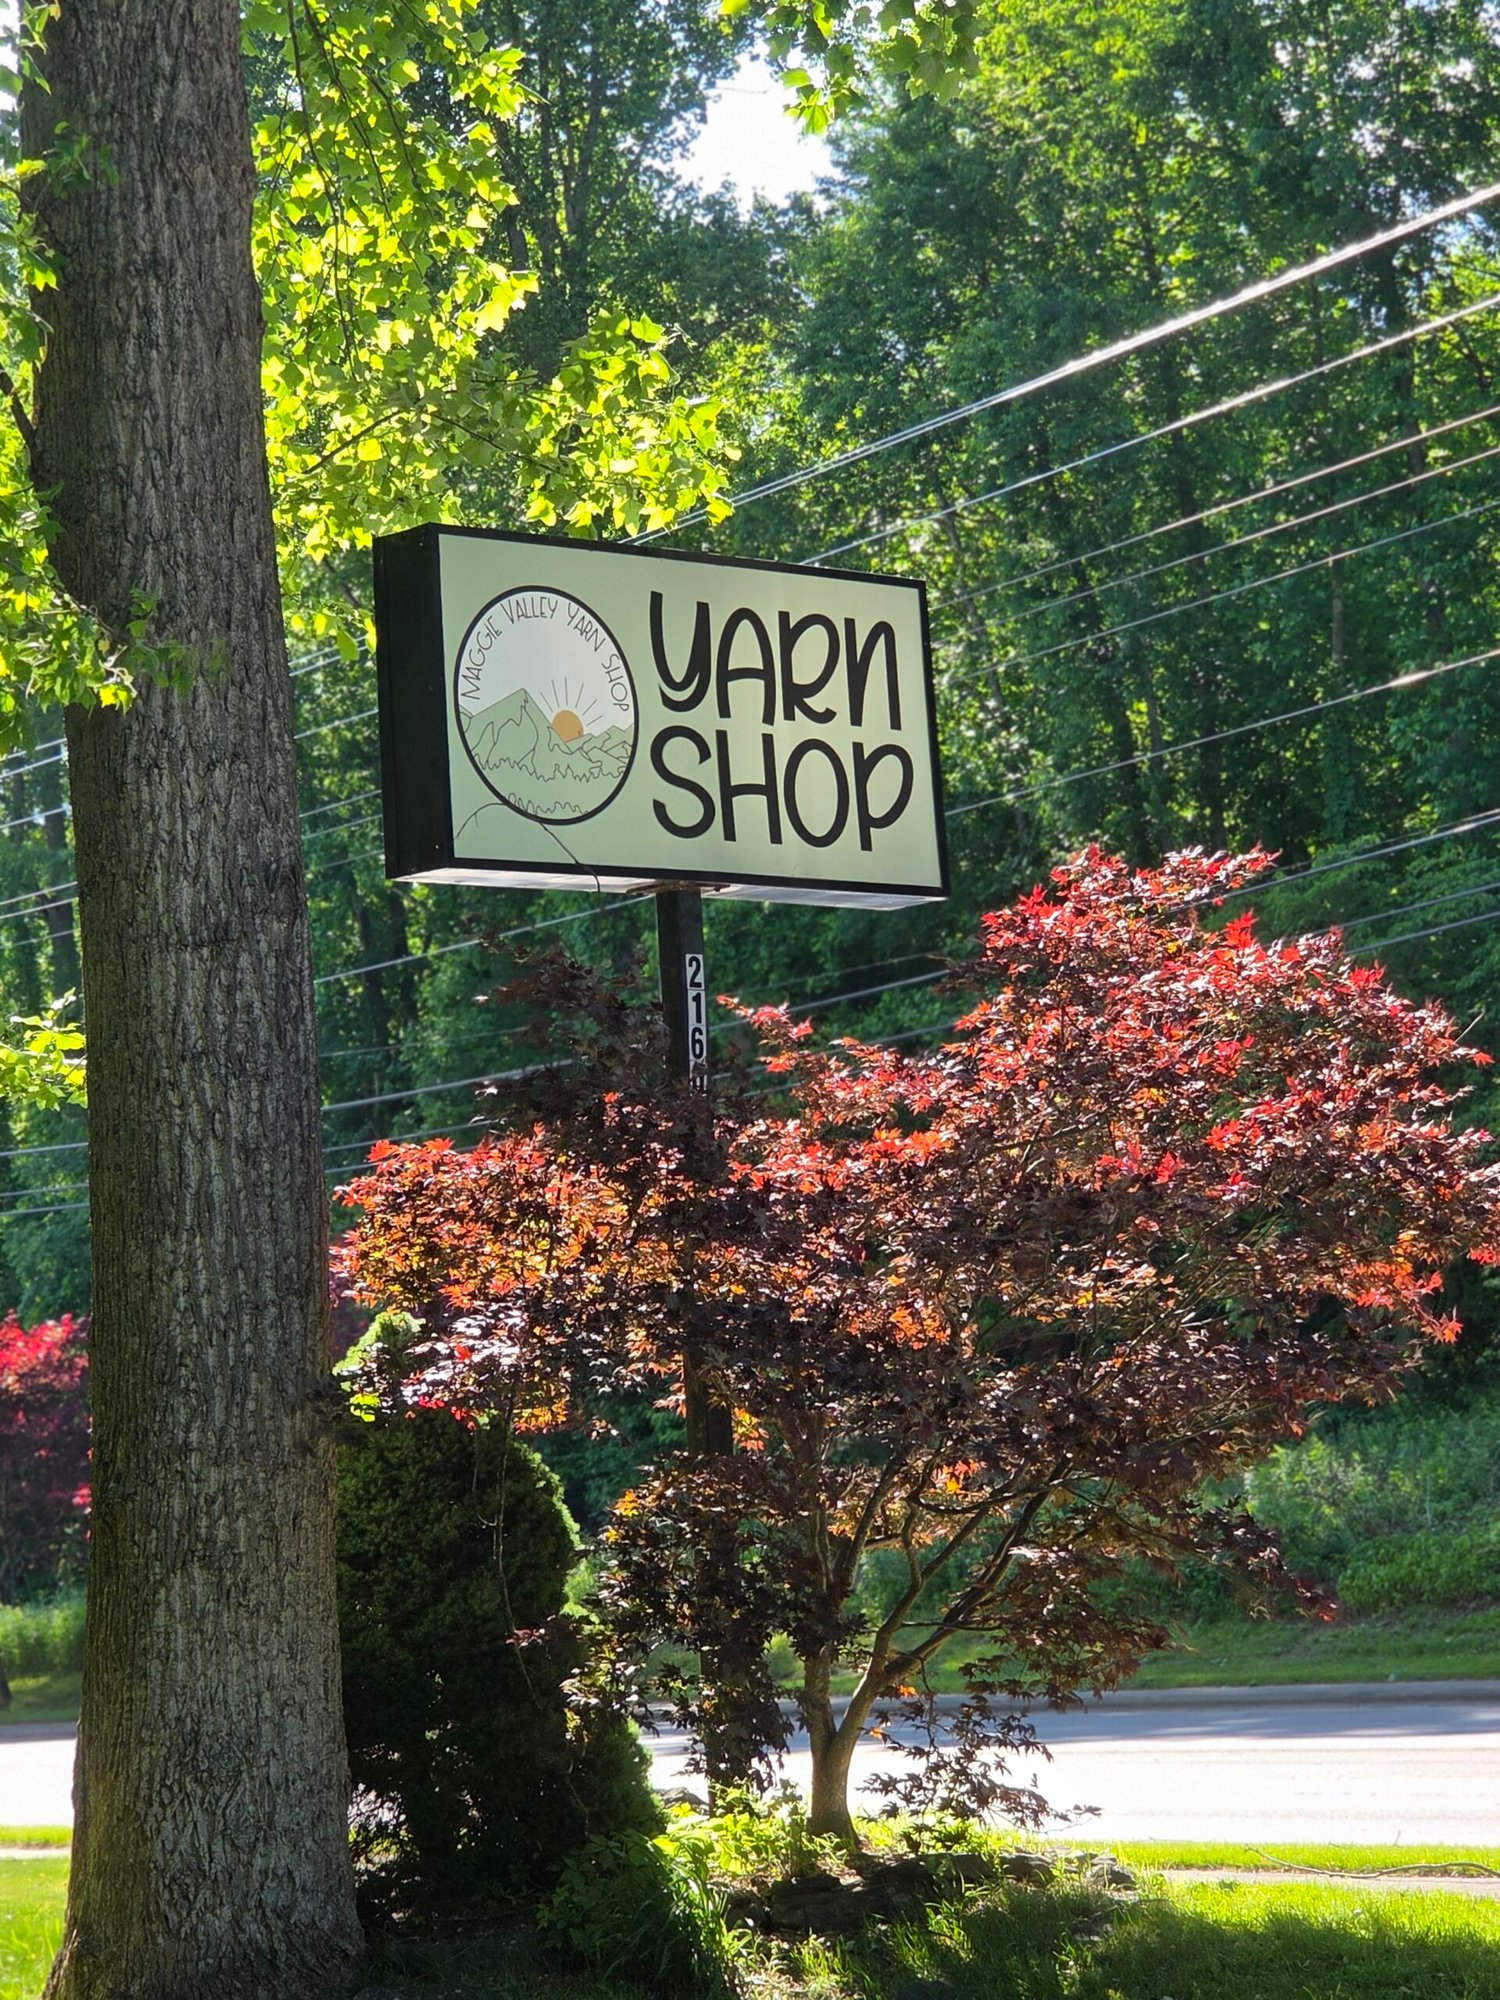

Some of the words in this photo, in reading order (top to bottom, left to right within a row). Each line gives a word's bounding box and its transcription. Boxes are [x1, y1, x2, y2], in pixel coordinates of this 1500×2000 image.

[461, 615, 502, 700] MAGGIE
[500, 596, 558, 624] VALLEY
[567, 602, 605, 652] YARN
[601, 653, 630, 712] SHOP
[650, 590, 902, 731] YARN
[650, 725, 914, 852] SHOP
